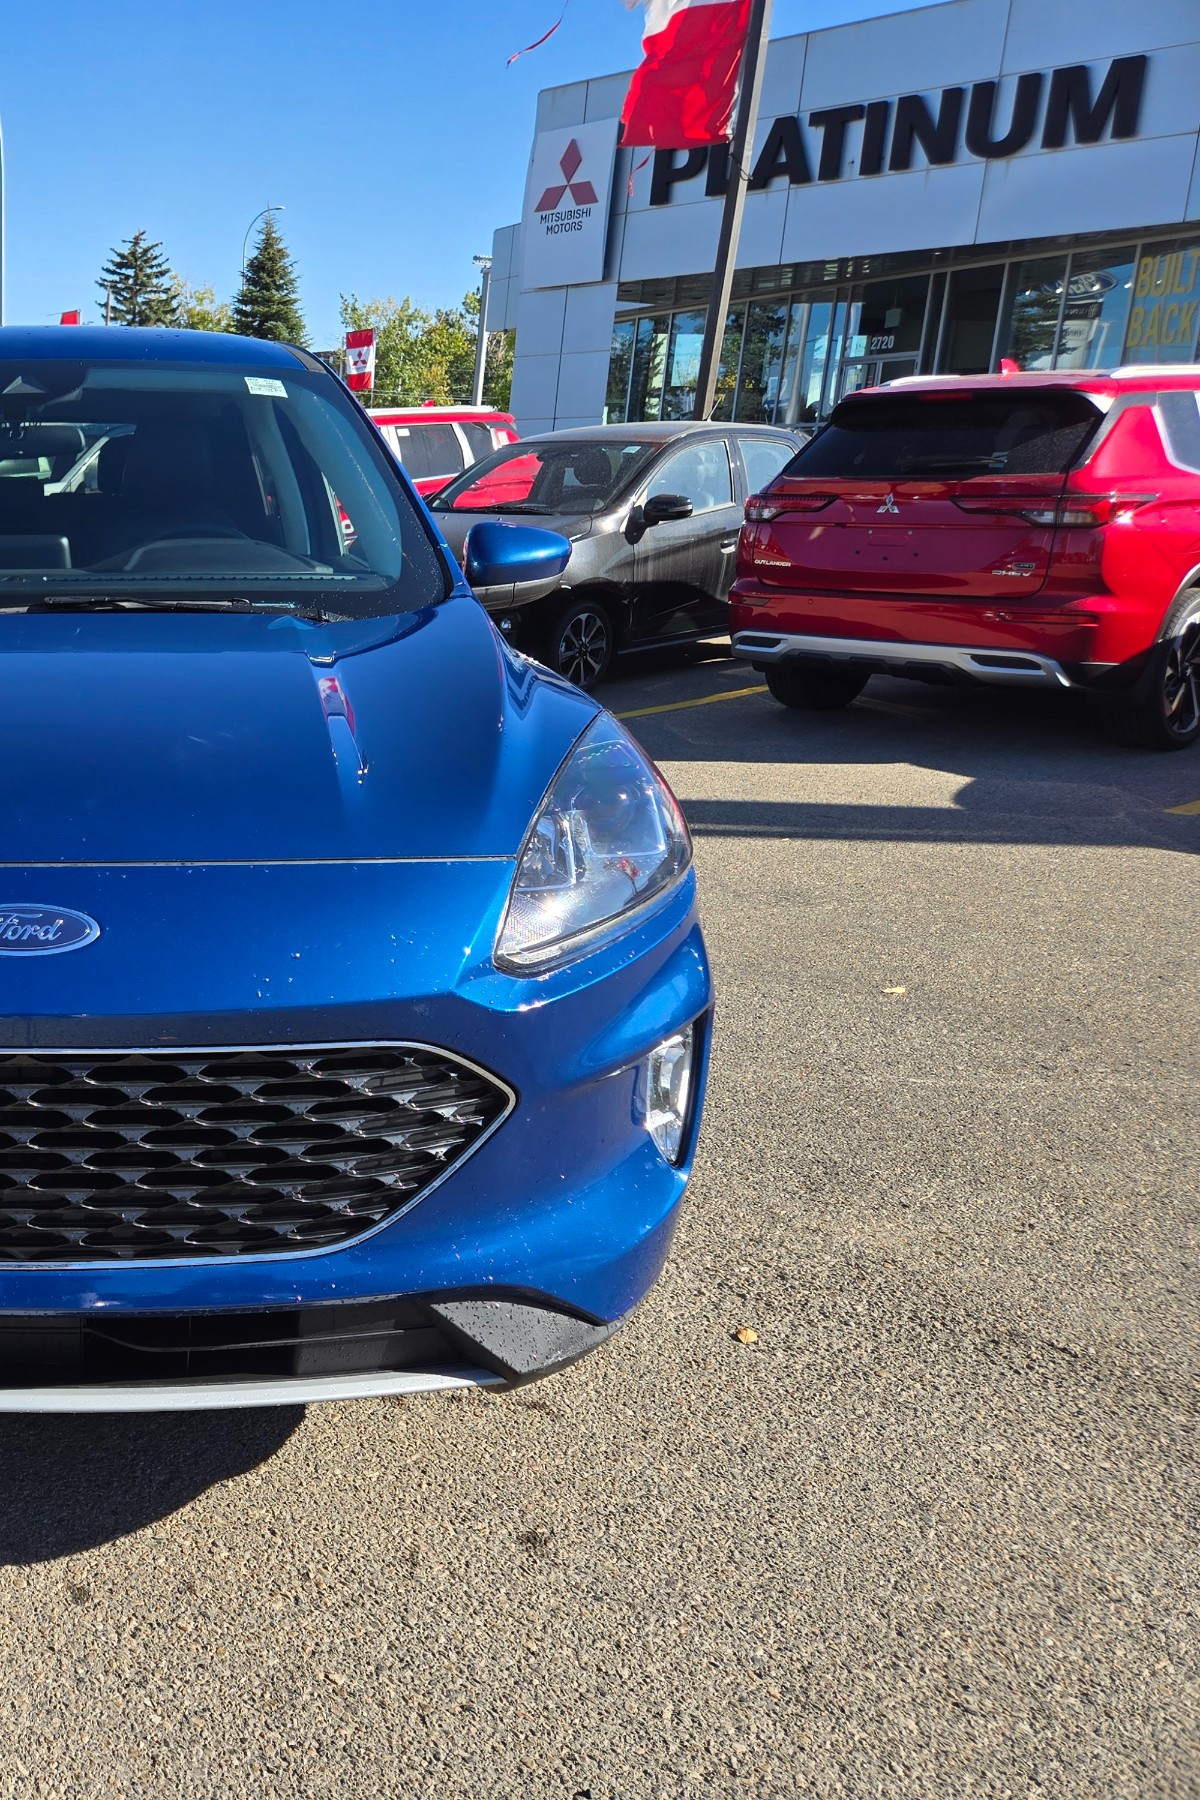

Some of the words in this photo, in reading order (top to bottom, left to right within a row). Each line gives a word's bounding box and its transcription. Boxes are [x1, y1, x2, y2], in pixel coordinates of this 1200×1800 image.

[650, 53, 1147, 206] PLATINUM
[540, 207, 592, 225] MITSUBISHI
[545, 221, 583, 235] MOTORS
[1136, 250, 1200, 297] BUILT
[1125, 300, 1199, 347] BACK
[870, 335, 895, 350] 2720
[754, 559, 792, 567] OUTLANDER
